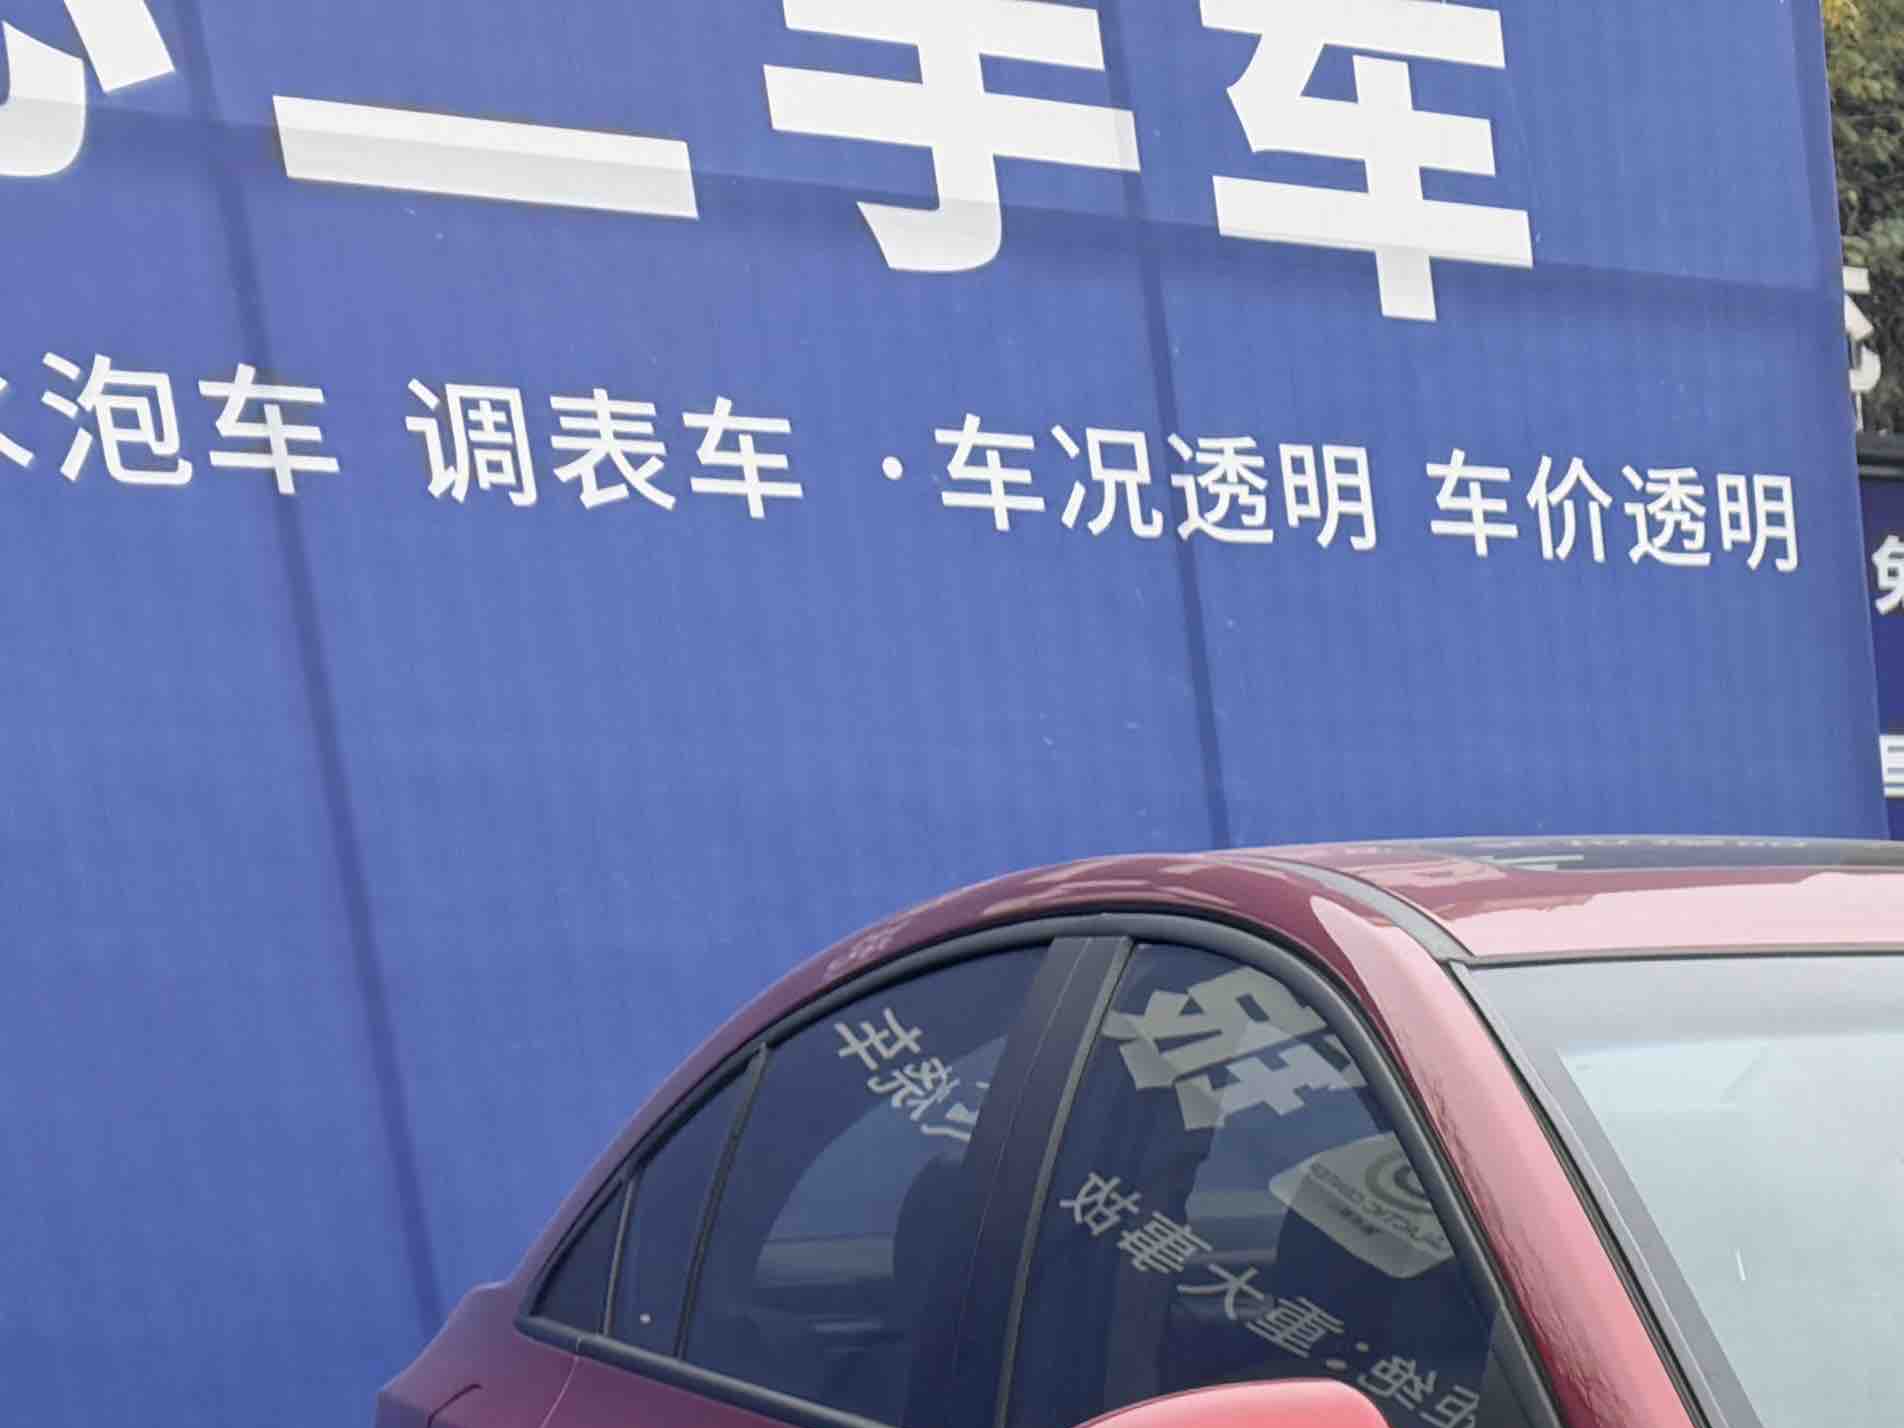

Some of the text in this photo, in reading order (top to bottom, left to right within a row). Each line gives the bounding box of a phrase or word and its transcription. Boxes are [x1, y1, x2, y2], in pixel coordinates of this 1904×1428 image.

[405, 379, 803, 518] 调表车
[1426, 448, 1800, 572] 车价透明
